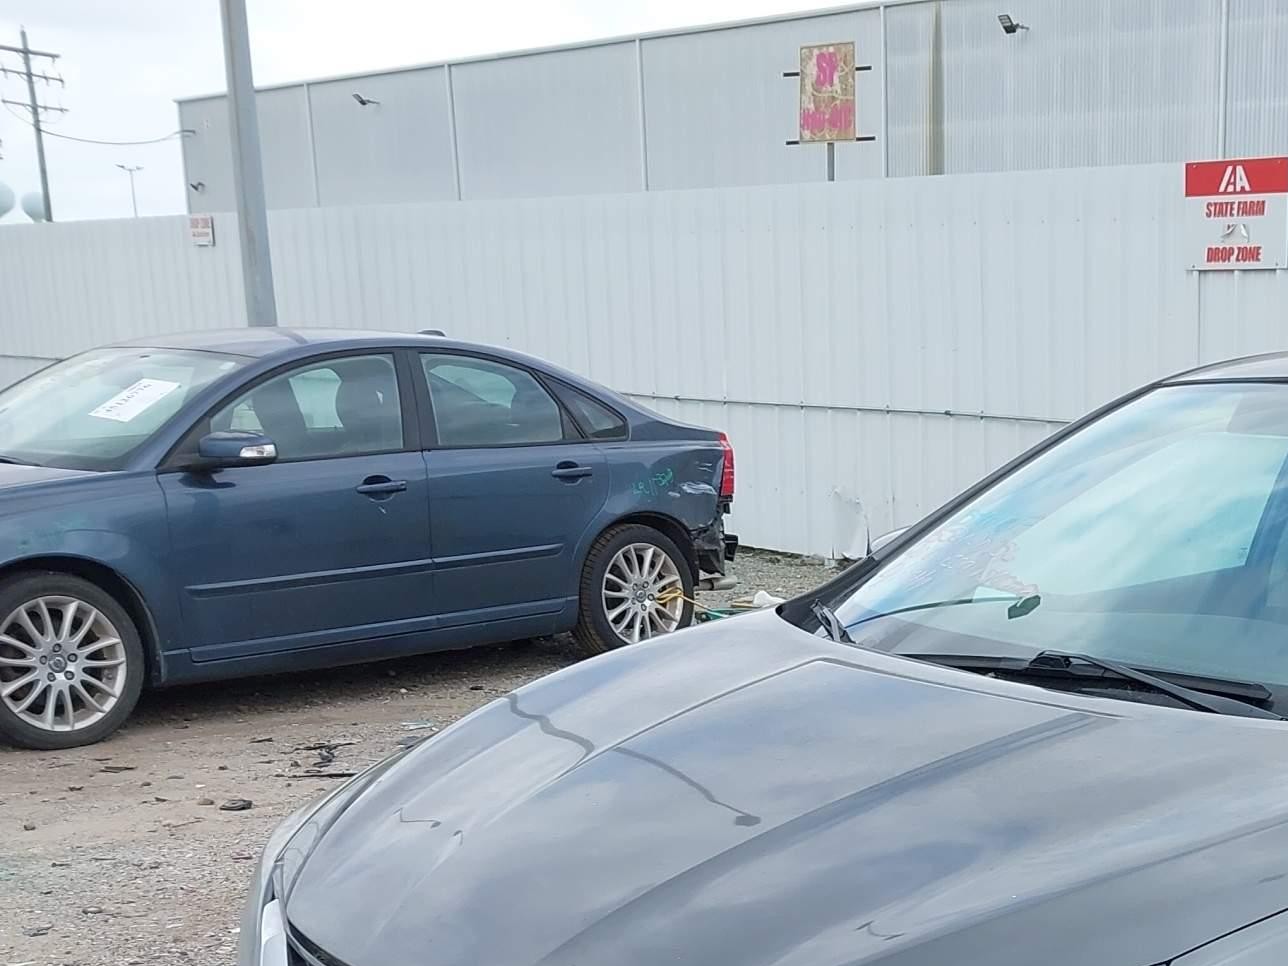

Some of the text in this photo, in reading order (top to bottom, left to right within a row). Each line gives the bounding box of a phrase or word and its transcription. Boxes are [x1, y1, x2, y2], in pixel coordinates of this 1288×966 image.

[1205, 200, 1266, 218] STATE FARM
[1206, 246, 1262, 263] DROP ZONE
